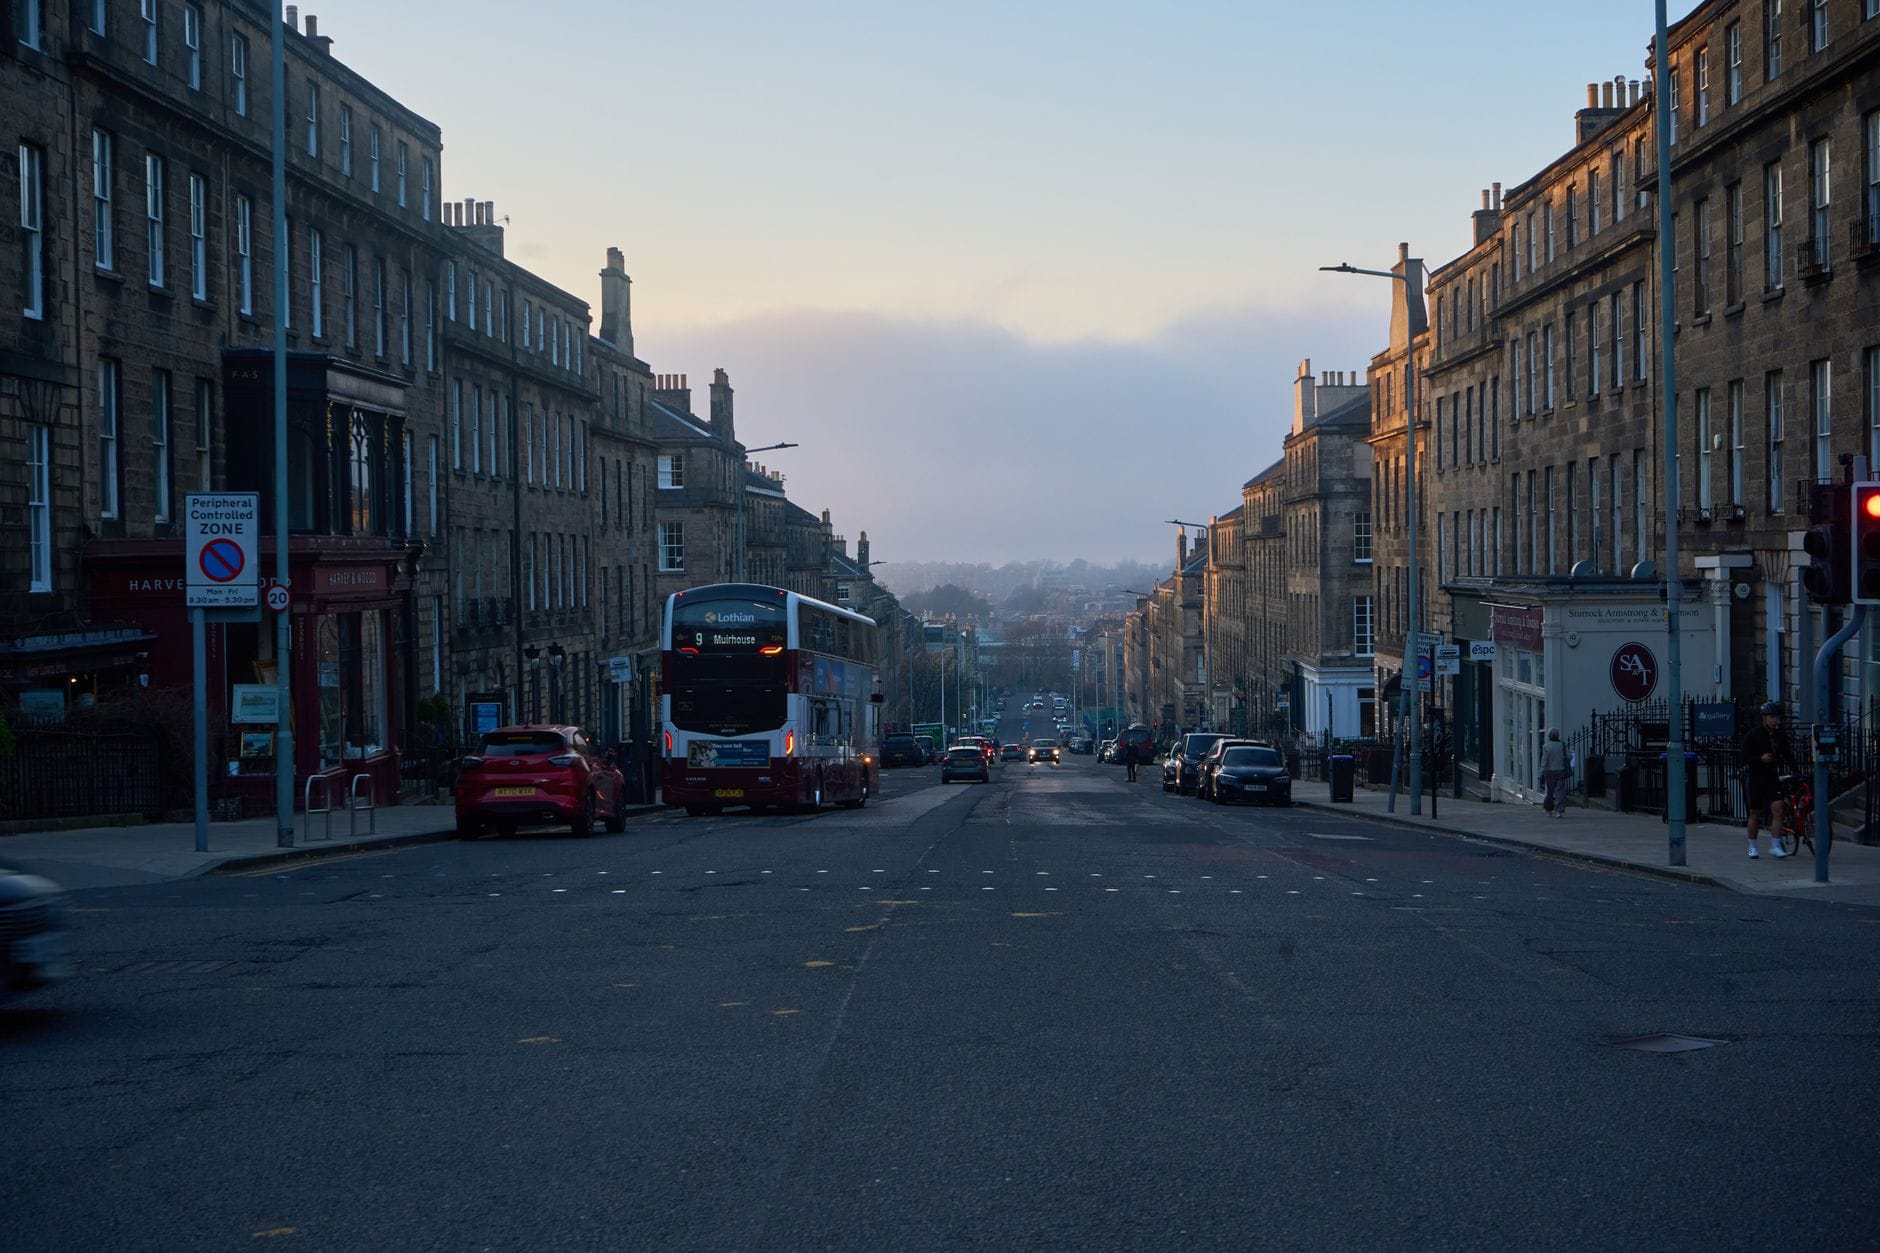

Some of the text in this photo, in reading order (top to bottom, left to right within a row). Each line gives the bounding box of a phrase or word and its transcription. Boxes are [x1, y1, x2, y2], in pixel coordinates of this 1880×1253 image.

[192, 498, 252, 509] Peripheral
[191, 510, 253, 520] Controlled
[200, 523, 243, 535] ZONE
[129, 577, 185, 591] HARVE
[269, 593, 288, 604] 20
[718, 612, 755, 623] Lothian
[1568, 608, 1603, 618] Sturrock
[1605, 608, 1648, 618] Armstrong
[1650, 608, 1658, 617] &
[695, 632, 756, 646] 9 Muirhouse
